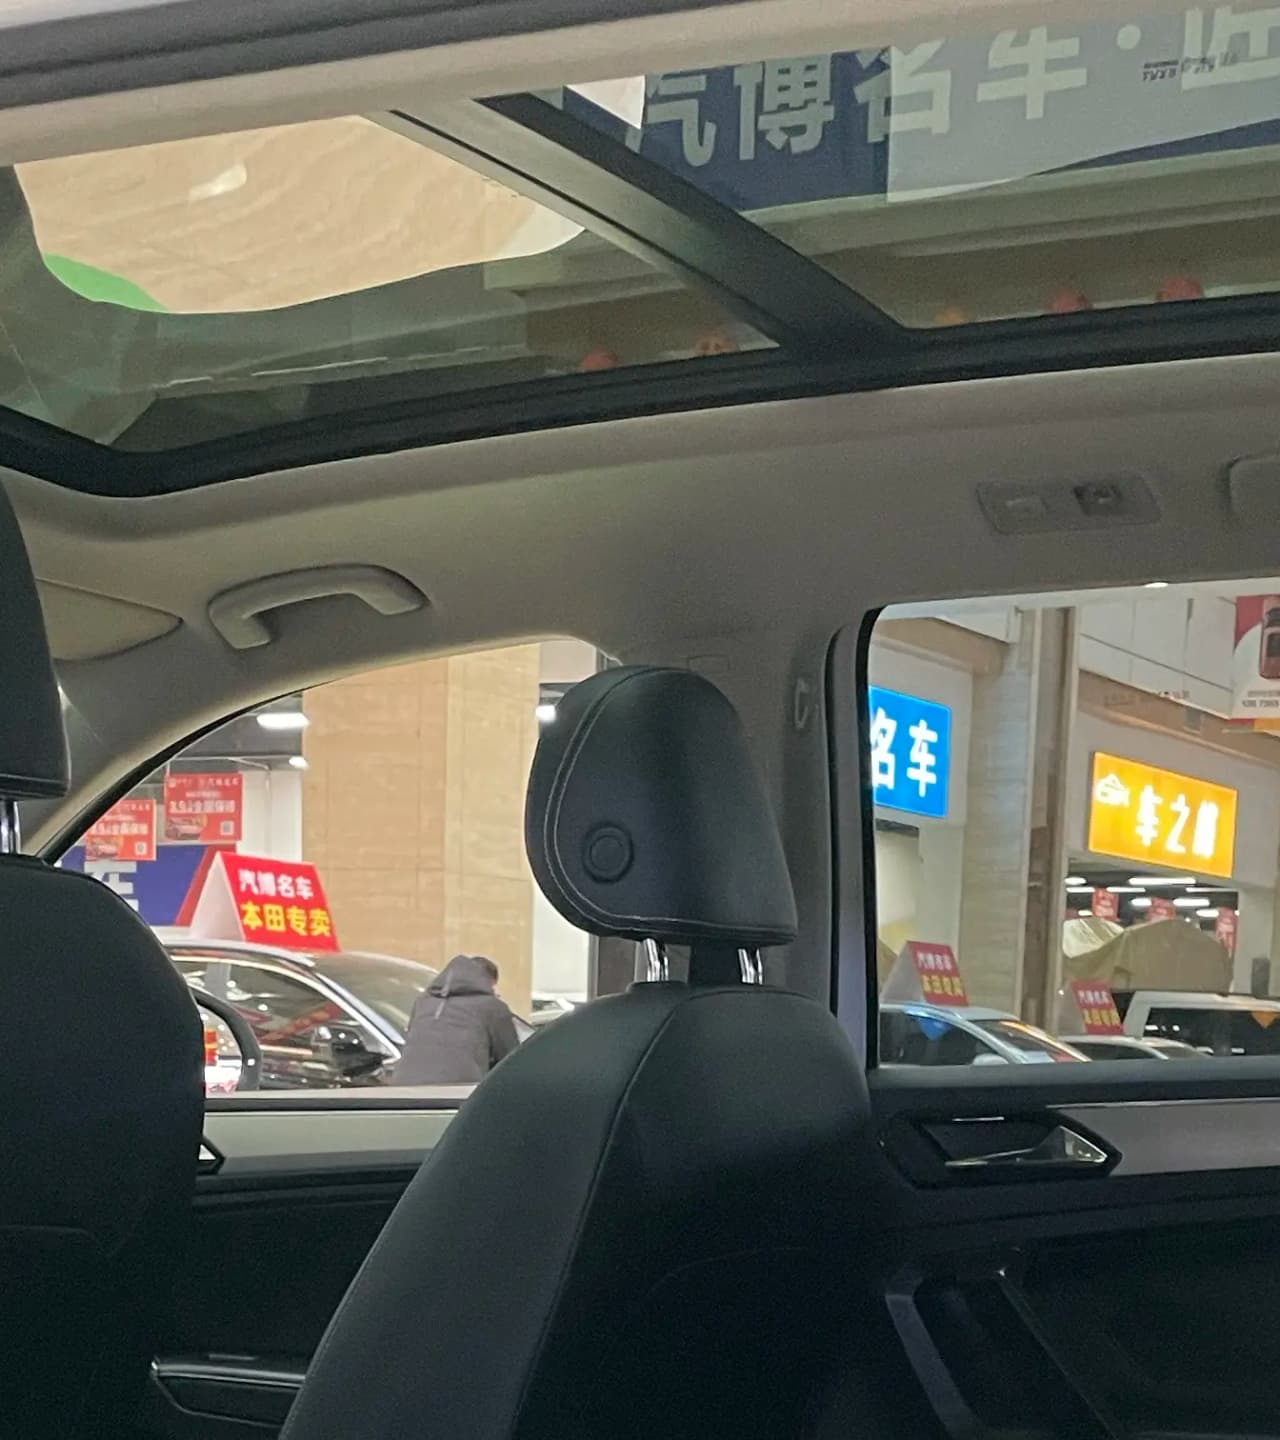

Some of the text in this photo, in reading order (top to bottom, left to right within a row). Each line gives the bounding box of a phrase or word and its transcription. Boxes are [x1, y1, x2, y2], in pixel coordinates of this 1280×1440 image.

[871, 706, 939, 798] 名车
[238, 868, 314, 900] 汽博名车
[240, 901, 332, 937] 本田专卖
